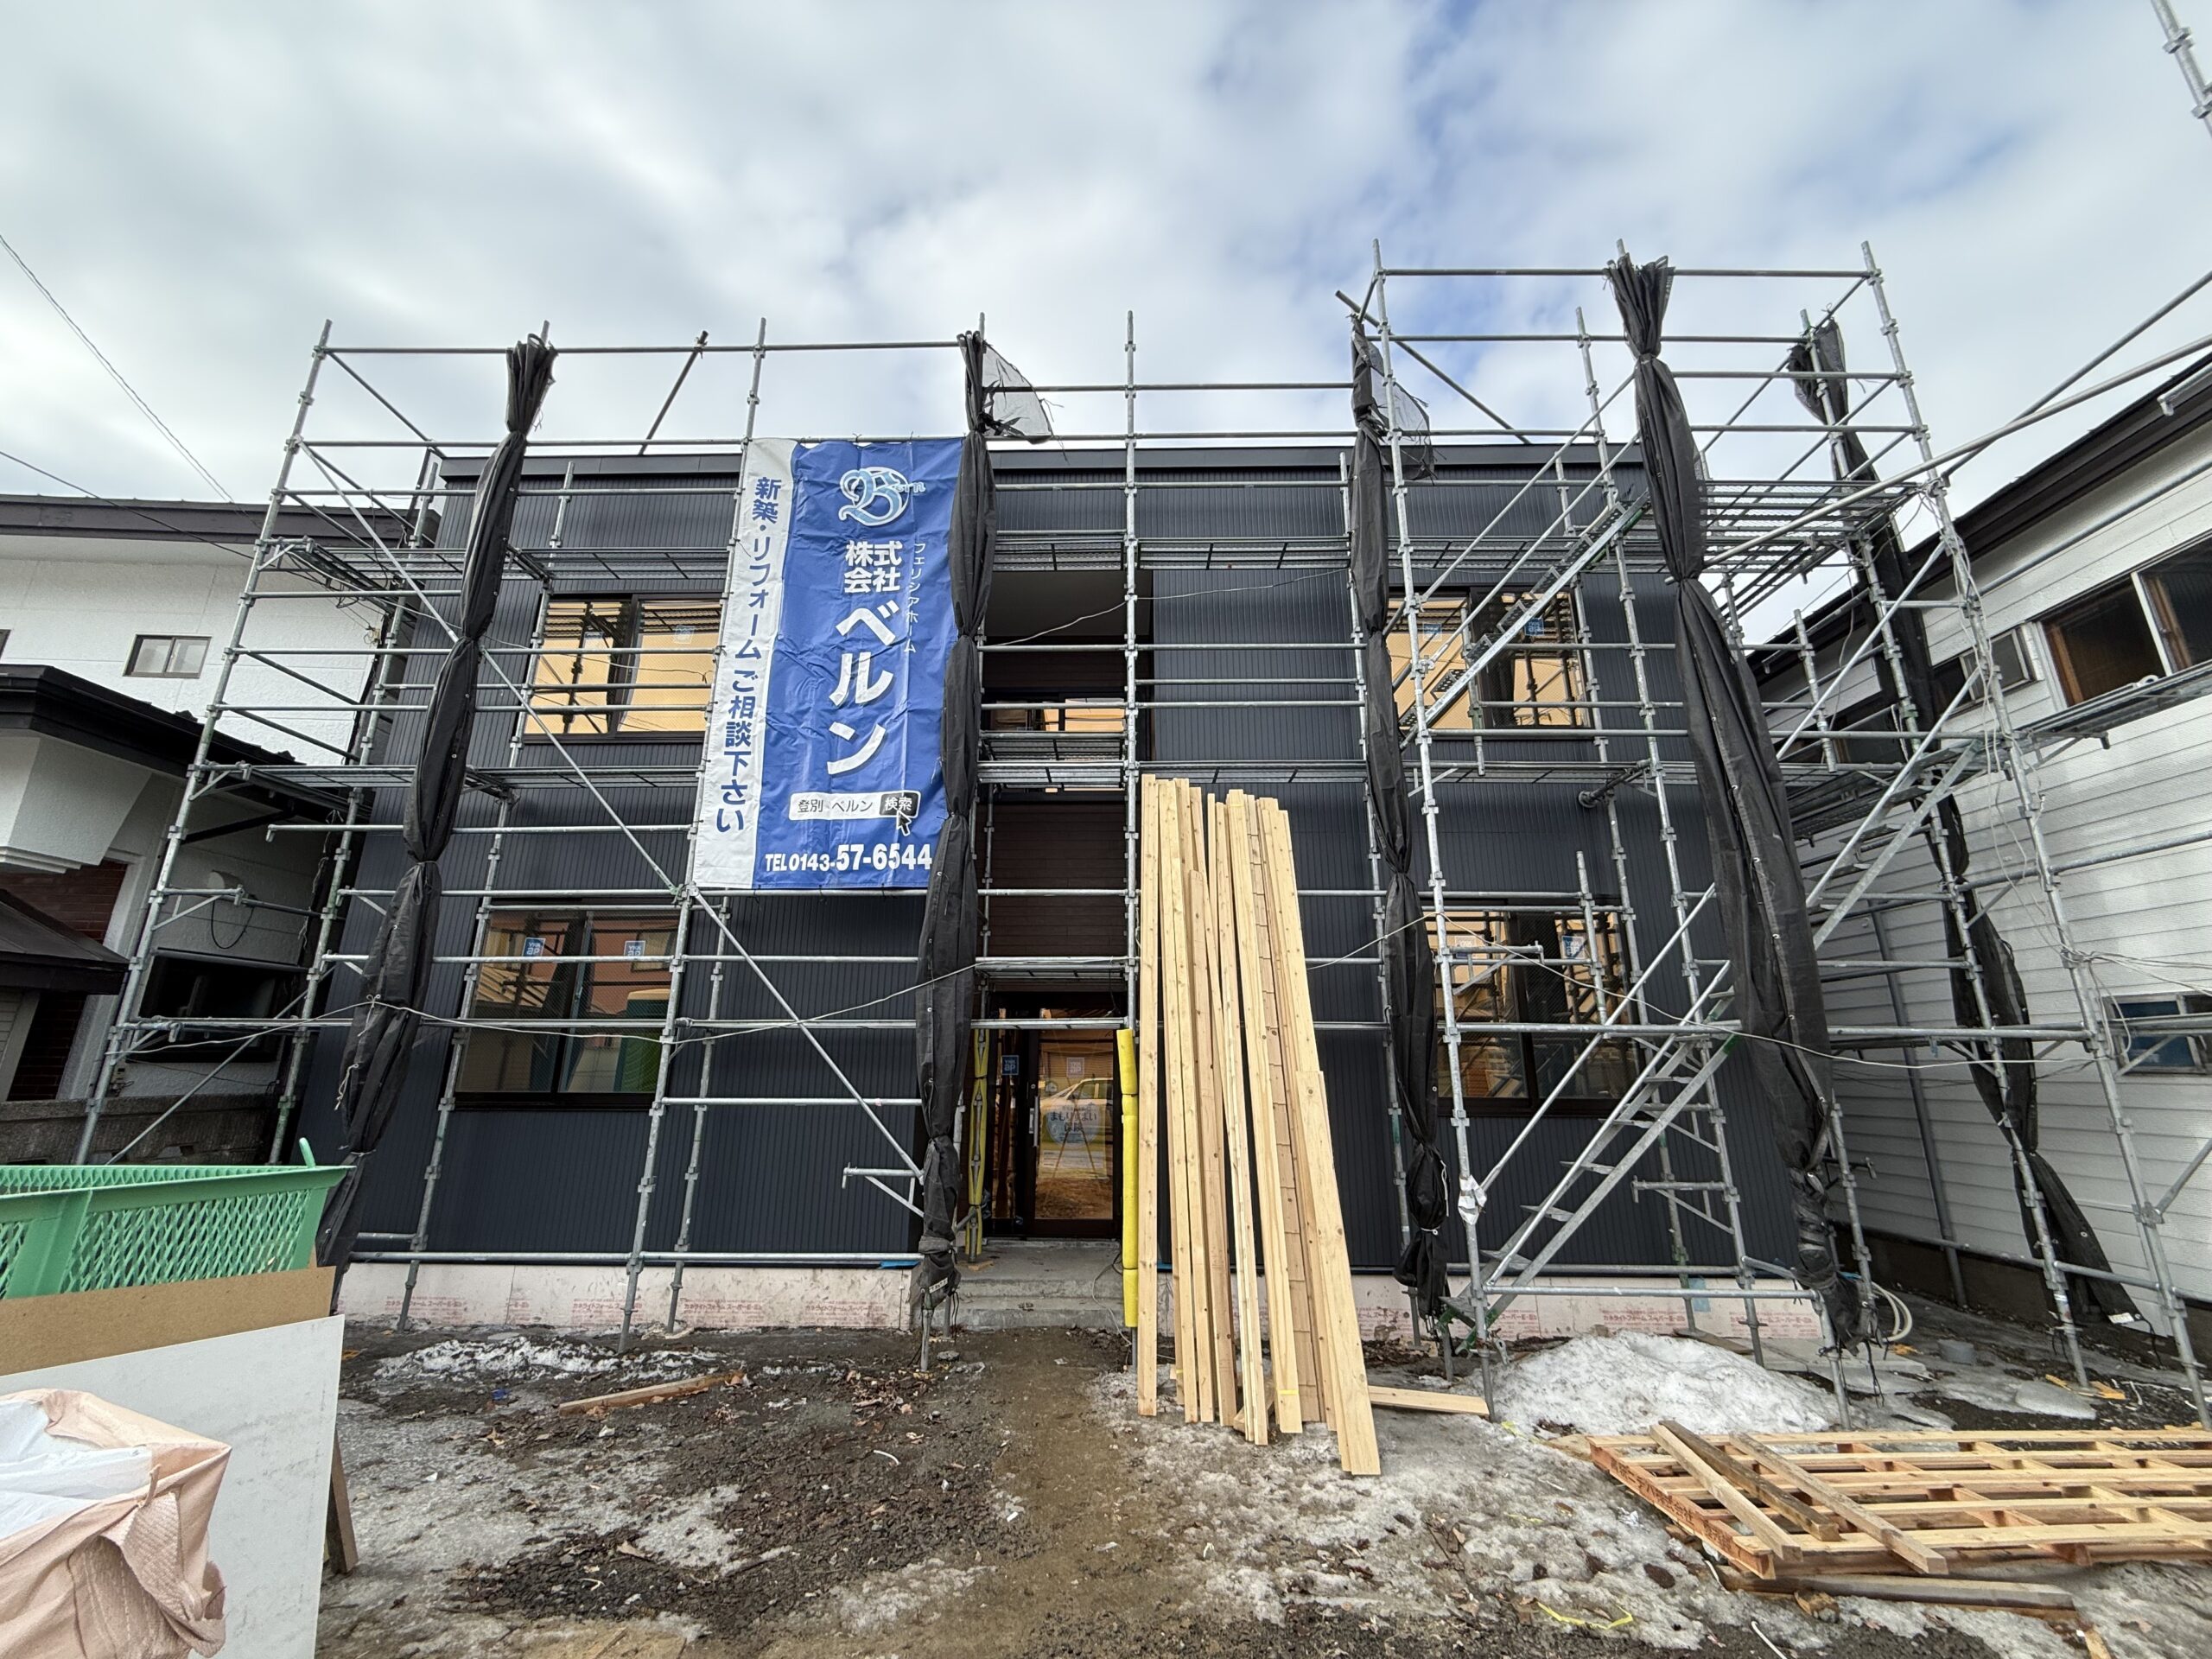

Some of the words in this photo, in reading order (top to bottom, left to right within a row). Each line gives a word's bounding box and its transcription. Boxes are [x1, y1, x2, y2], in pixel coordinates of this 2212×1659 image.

[715, 476, 782, 833] 新築・リフォームご相談下さい
[903, 543, 926, 653] フェリシアホーム
[827, 599, 899, 775] ベルン
[798, 799, 823, 813] 登別
[831, 800, 874, 813] ベルン
[885, 797, 912, 810] 検索
